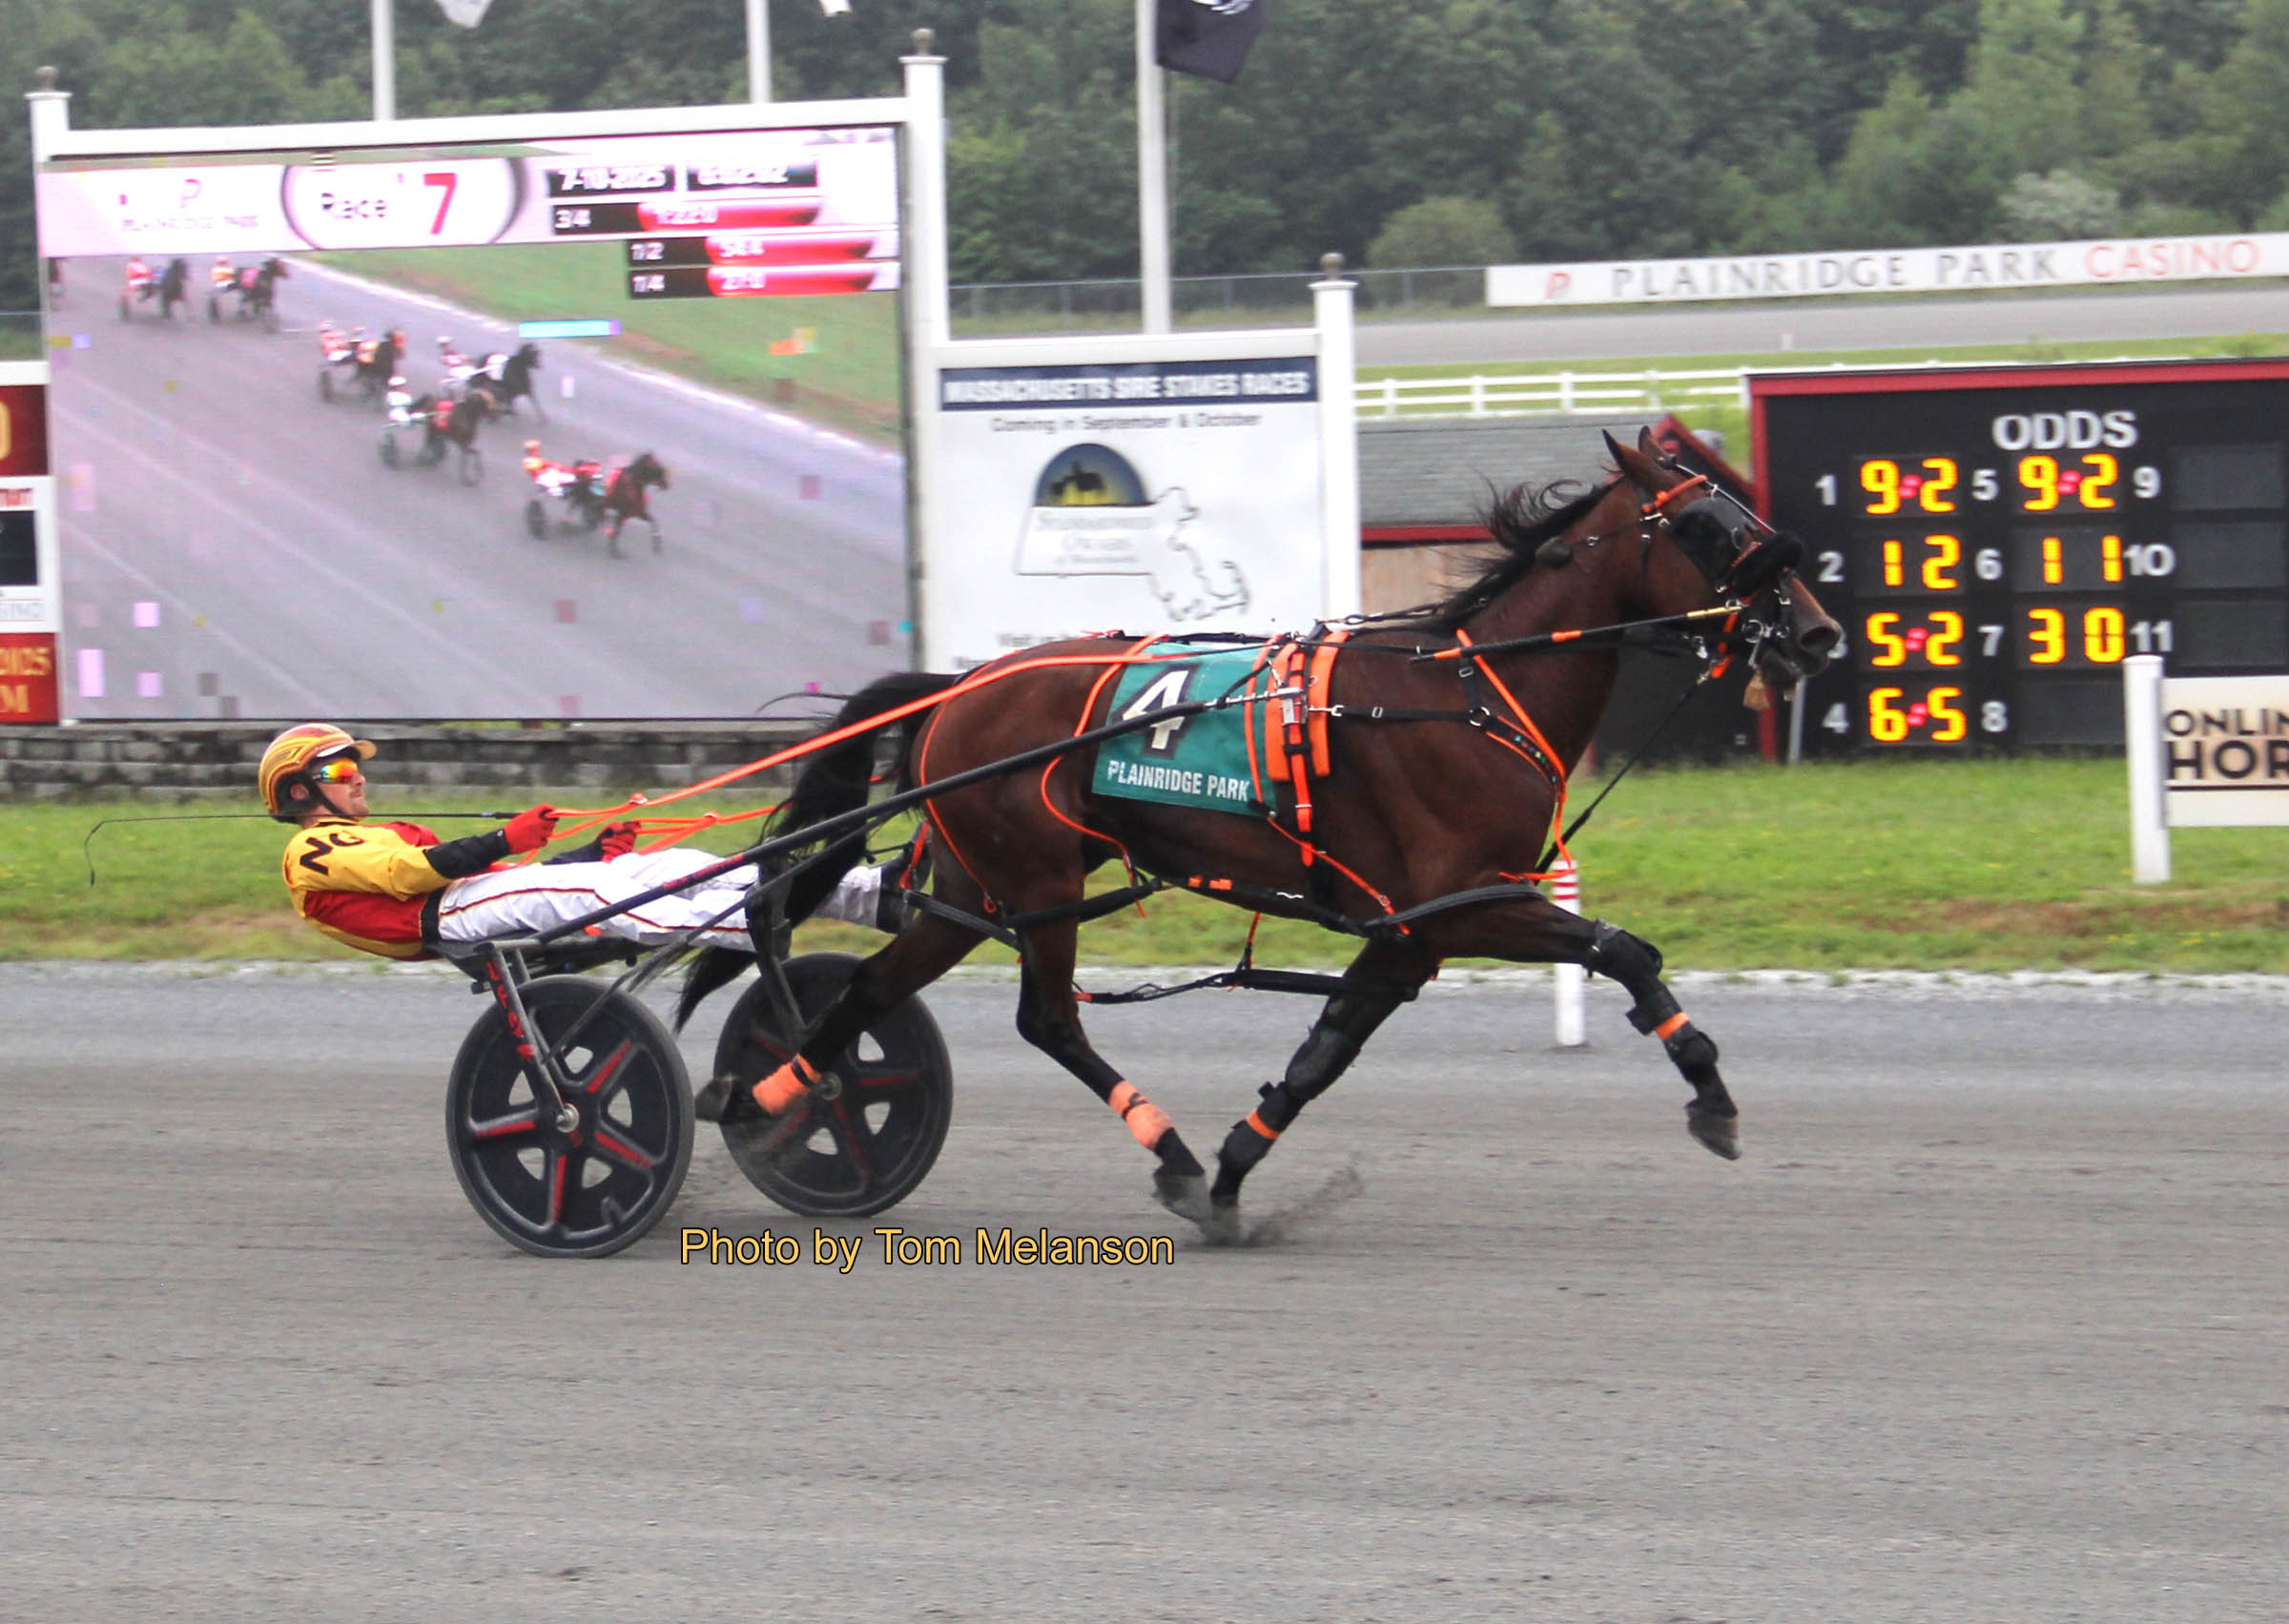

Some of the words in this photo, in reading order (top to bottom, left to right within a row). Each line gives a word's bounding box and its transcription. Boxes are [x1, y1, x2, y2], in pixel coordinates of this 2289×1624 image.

[423, 171, 457, 236] 7
[1611, 255, 1906, 298] PLAINRIDGE
[1937, 249, 2058, 284] PARK
[2084, 238, 2260, 278] CASINO
[1993, 411, 2138, 450] ODDS
[1816, 476, 1837, 505] 1
[1972, 469, 1999, 501] 5
[2133, 466, 2161, 498] 9
[1818, 552, 1844, 582] 2
[1975, 549, 2002, 580] 6
[2124, 545, 2175, 576] 10
[1978, 626, 2004, 657] 7
[2130, 621, 2174, 652] 11
[1122, 669, 1189, 750] 4
[1822, 703, 1849, 733] 4
[1981, 702, 2007, 731] 8
[2167, 740, 2289, 780] HOR
[1106, 759, 1202, 795] PLAINRIDGE
[1206, 777, 1250, 803] PARK
